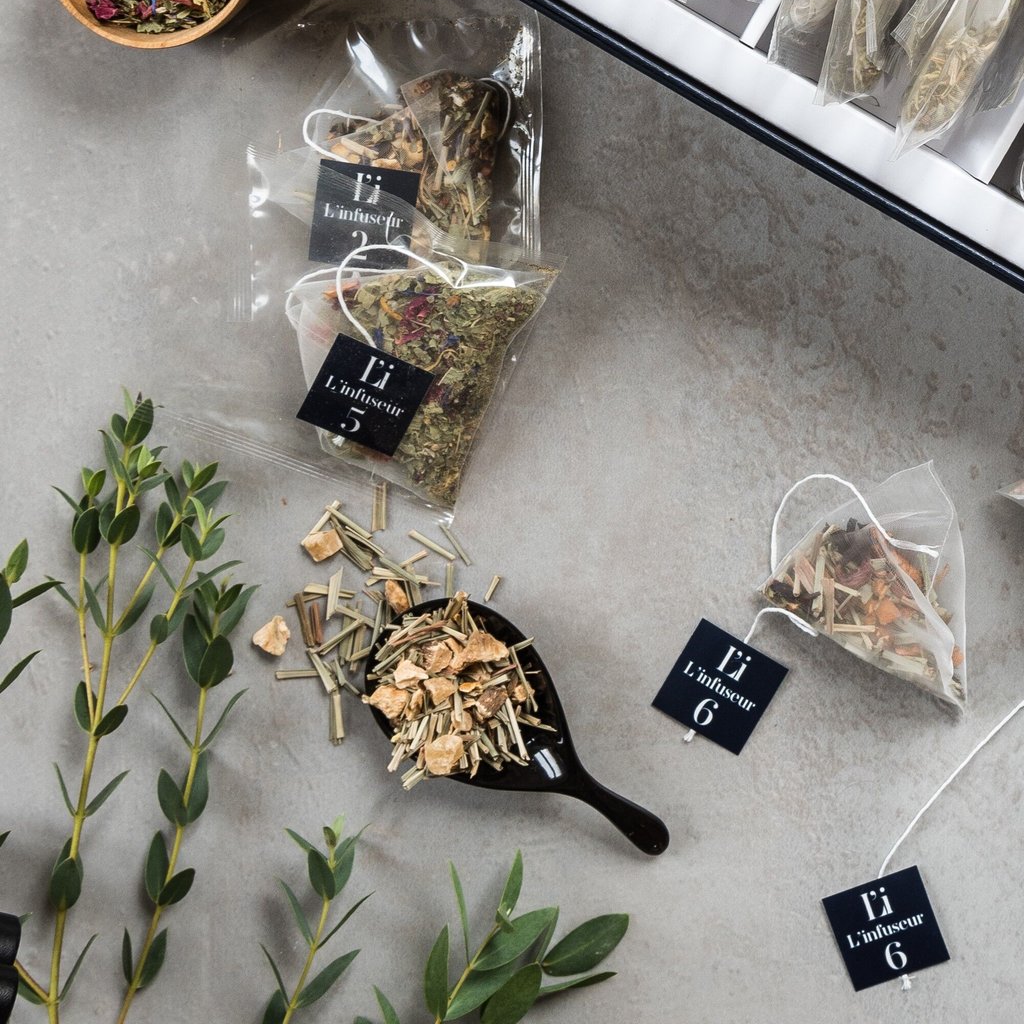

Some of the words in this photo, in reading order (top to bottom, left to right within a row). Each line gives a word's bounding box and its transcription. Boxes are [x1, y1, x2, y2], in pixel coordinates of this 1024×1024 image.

[351, 230, 368, 261] 2
[324, 374, 405, 418] L'infuseur
[340, 406, 366, 433] 5
[683, 660, 756, 712] L'infuseur
[692, 697, 719, 727] 6
[847, 912, 924, 949] L'infuseur
[884, 941, 908, 971] 6
